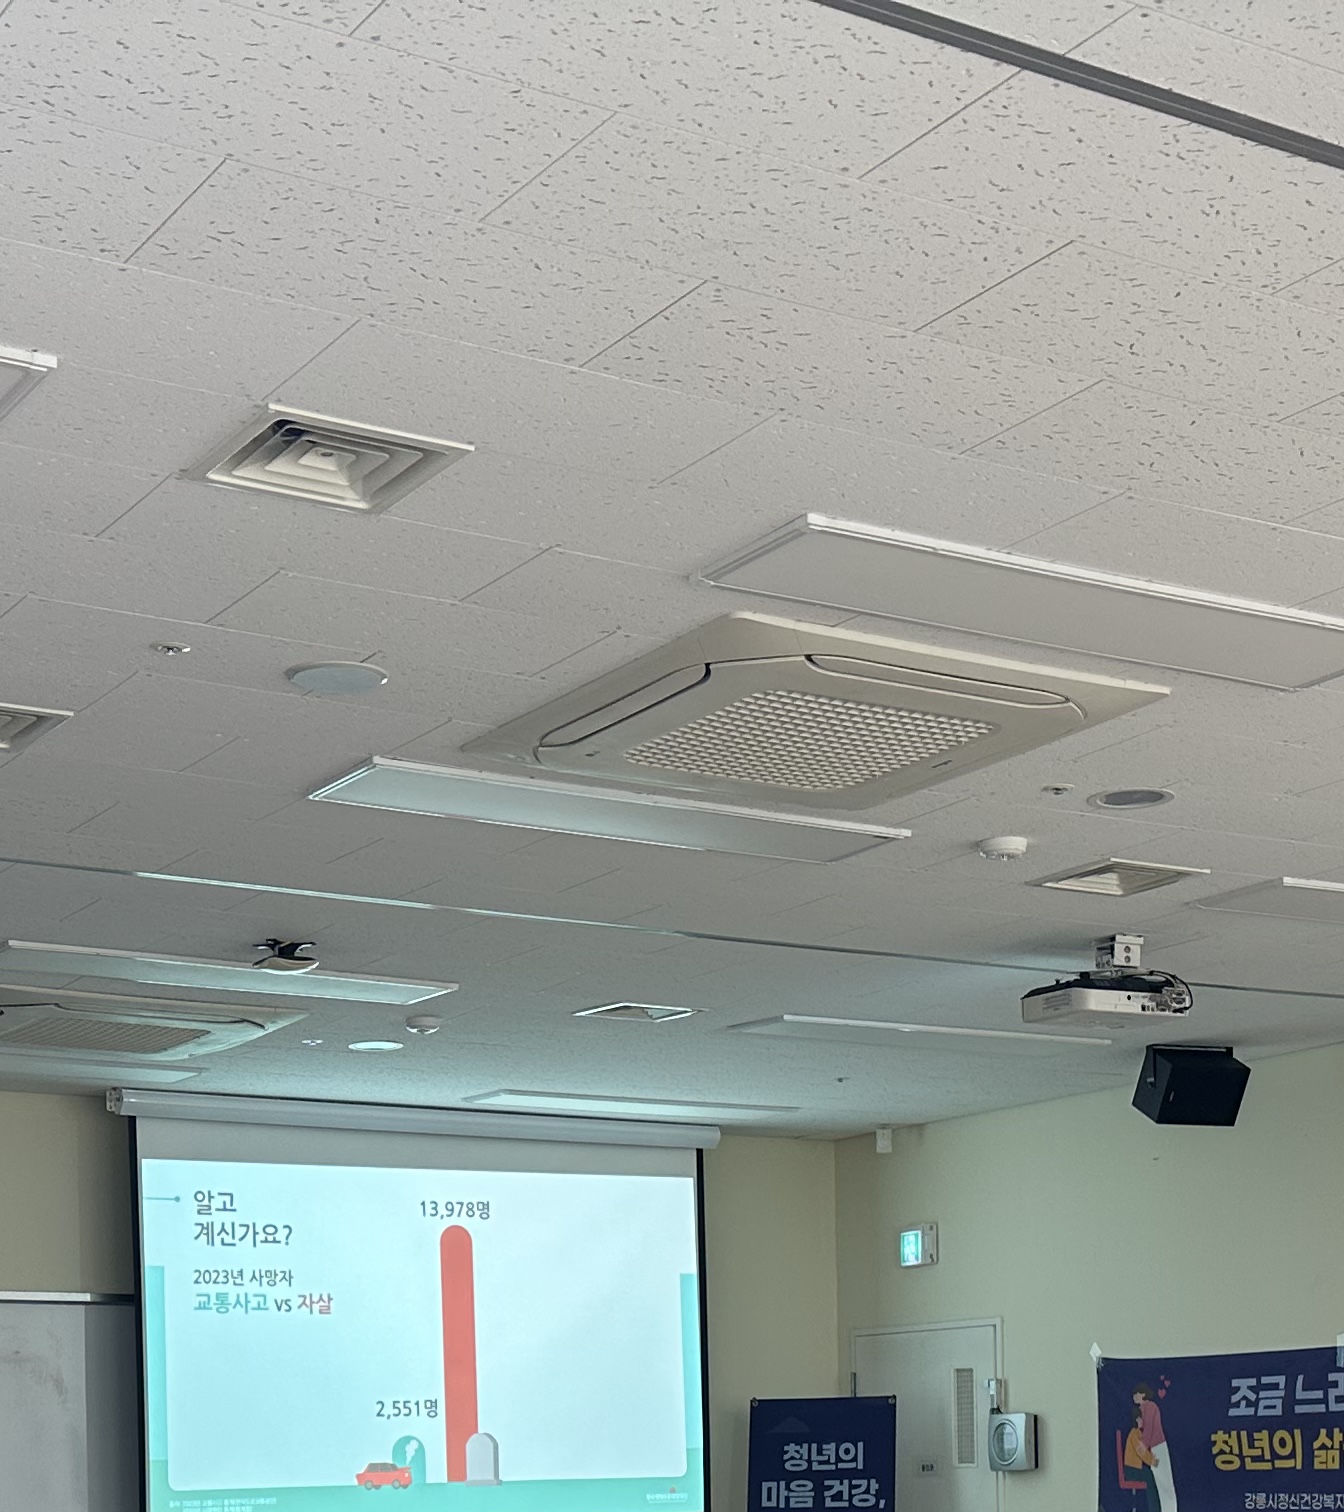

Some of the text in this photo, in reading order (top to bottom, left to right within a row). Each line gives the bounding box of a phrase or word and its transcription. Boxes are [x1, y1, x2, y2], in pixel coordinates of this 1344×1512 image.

[193, 1190, 237, 1216] 알고
[420, 1200, 491, 1221] 13,978명
[193, 1221, 293, 1248] 계신가요?
[193, 1268, 294, 1288] 2023년 사망자
[193, 1292, 334, 1315] 교통사고 vs 자살
[376, 1398, 438, 1420] 2,551명
[1227, 1375, 1286, 1417] 조금
[783, 1441, 864, 1472] 청년의
[1211, 1428, 1303, 1471] 청년의
[761, 1478, 886, 1509] 마음 건강,
